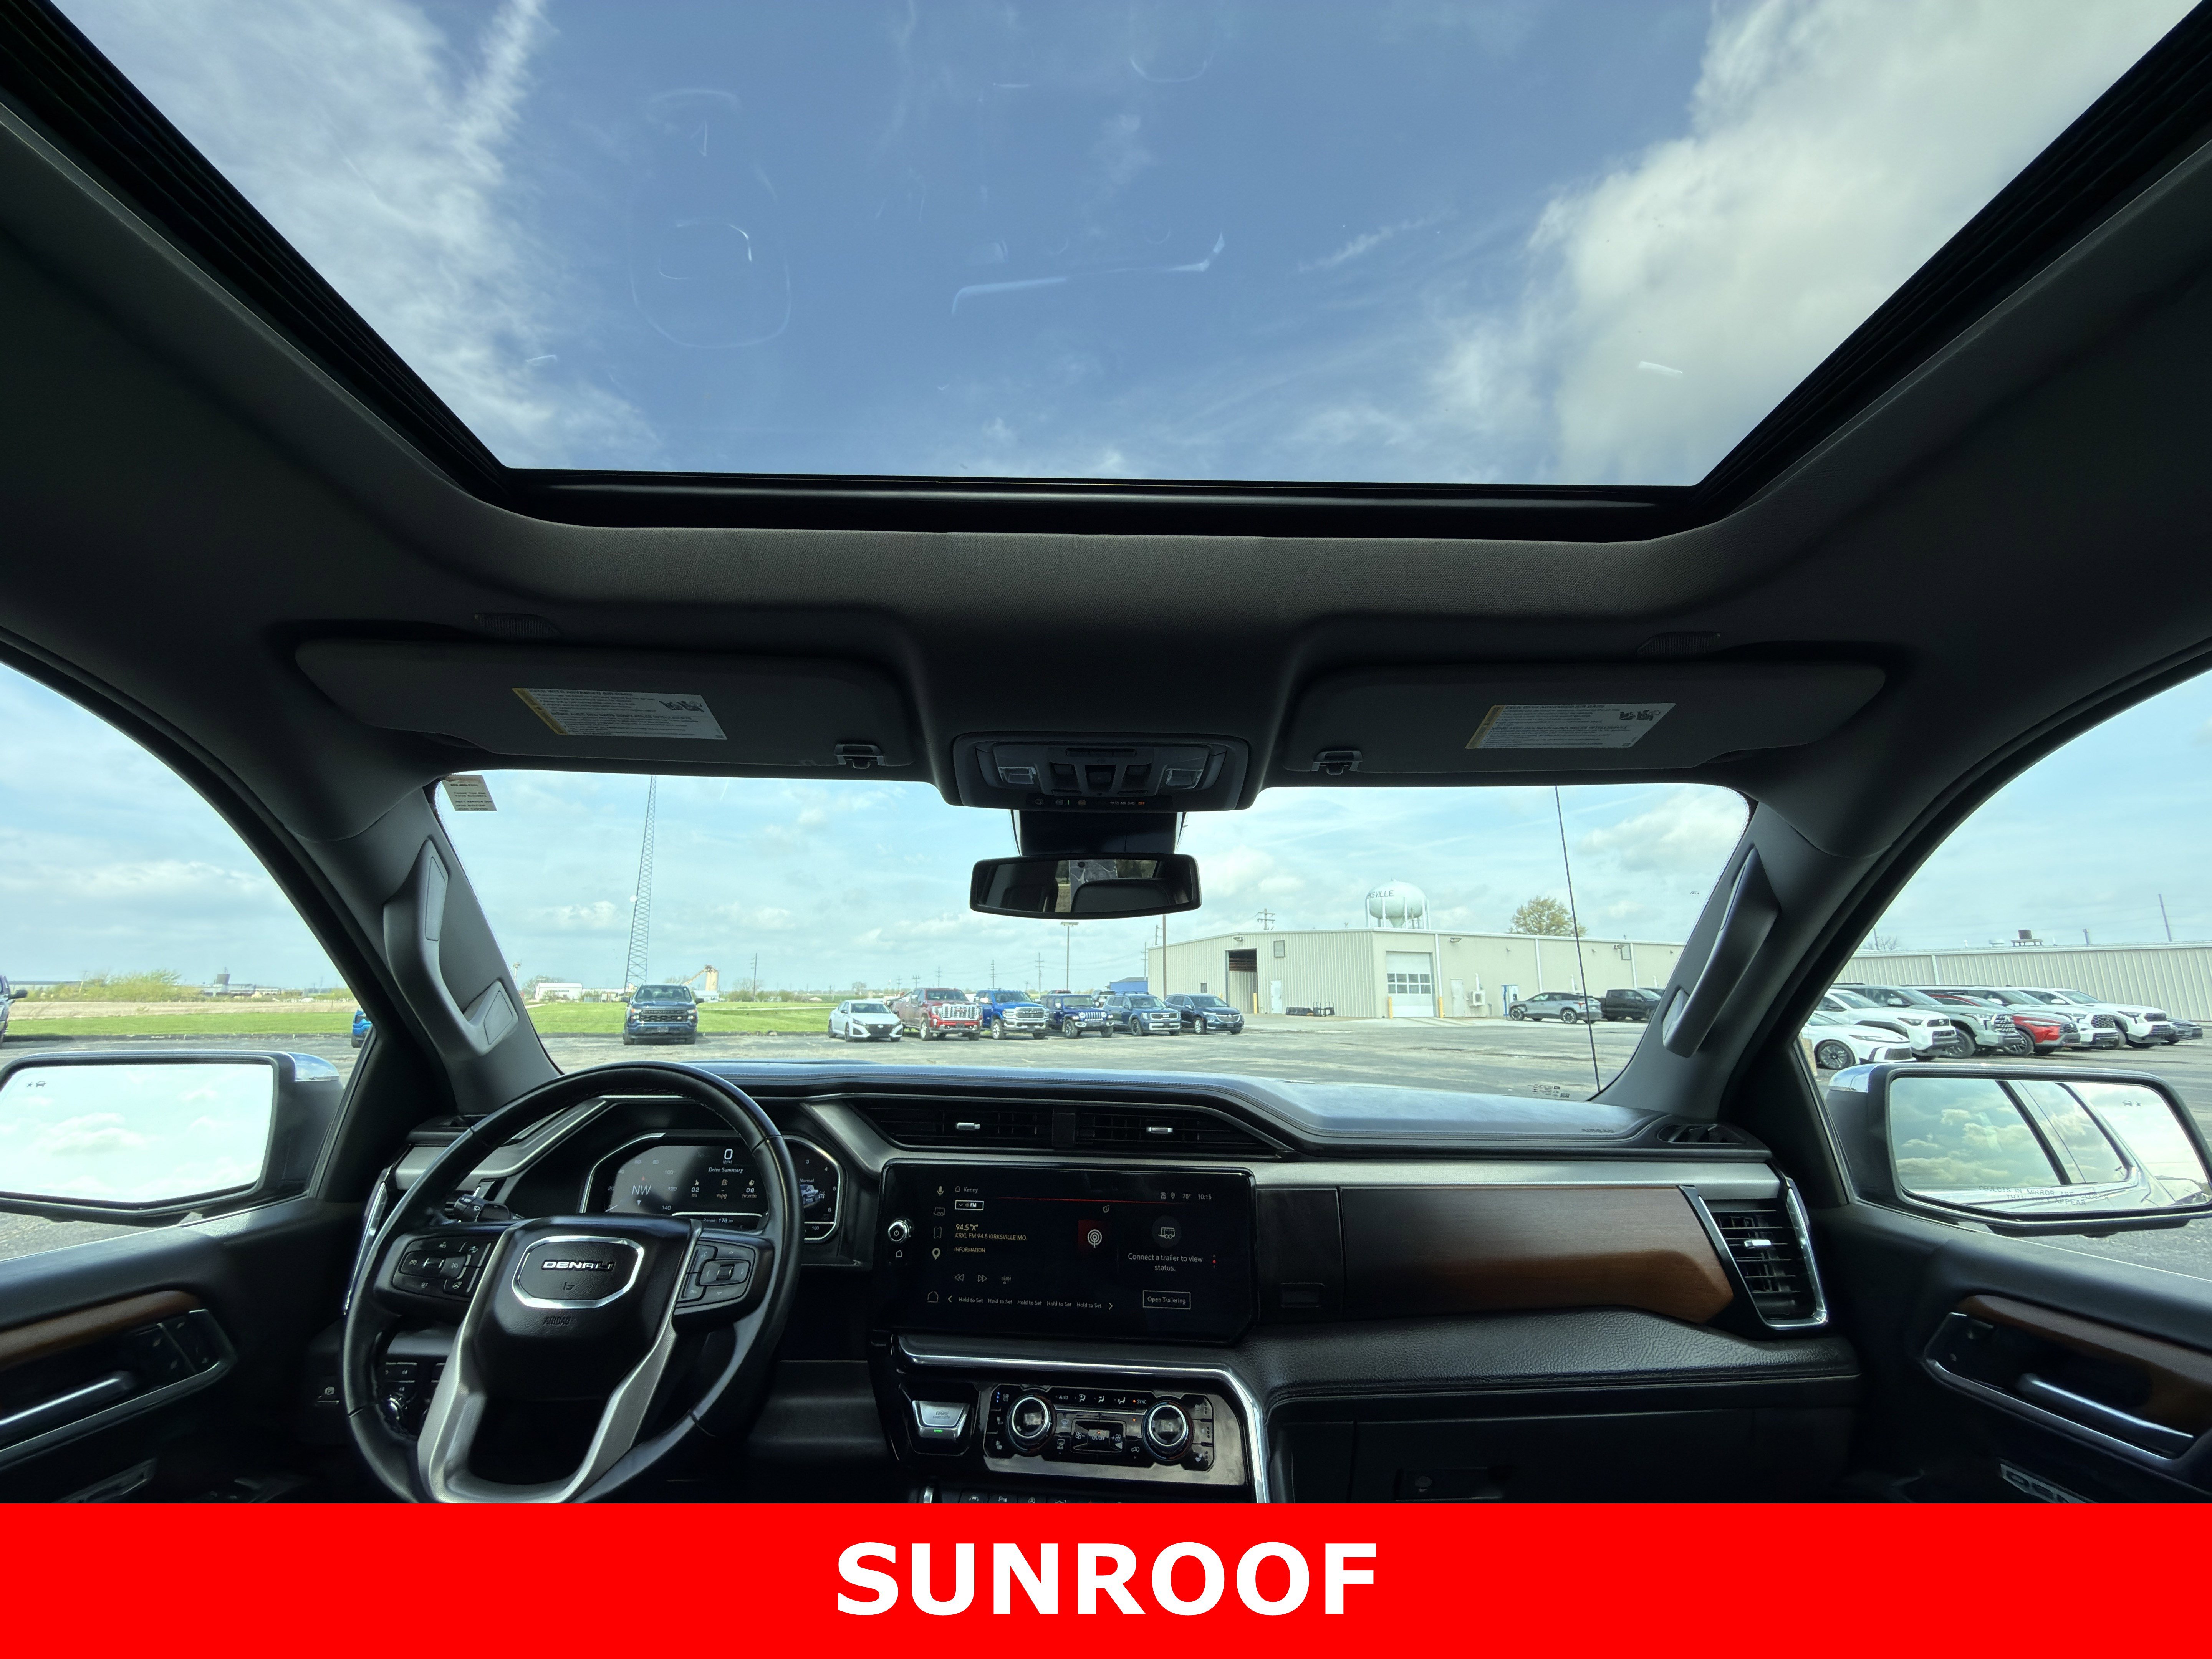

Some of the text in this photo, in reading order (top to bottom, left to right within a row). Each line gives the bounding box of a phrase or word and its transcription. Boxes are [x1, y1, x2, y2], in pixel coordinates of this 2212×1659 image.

[724, 1148, 733, 1160] 0
[632, 1185, 651, 1195] NW
[2055, 1198, 2087, 1206] APPEAR
[1128, 1253, 1154, 1261] Connect
[1161, 1254, 1179, 1262] trailer
[543, 1261, 613, 1269] DENALI
